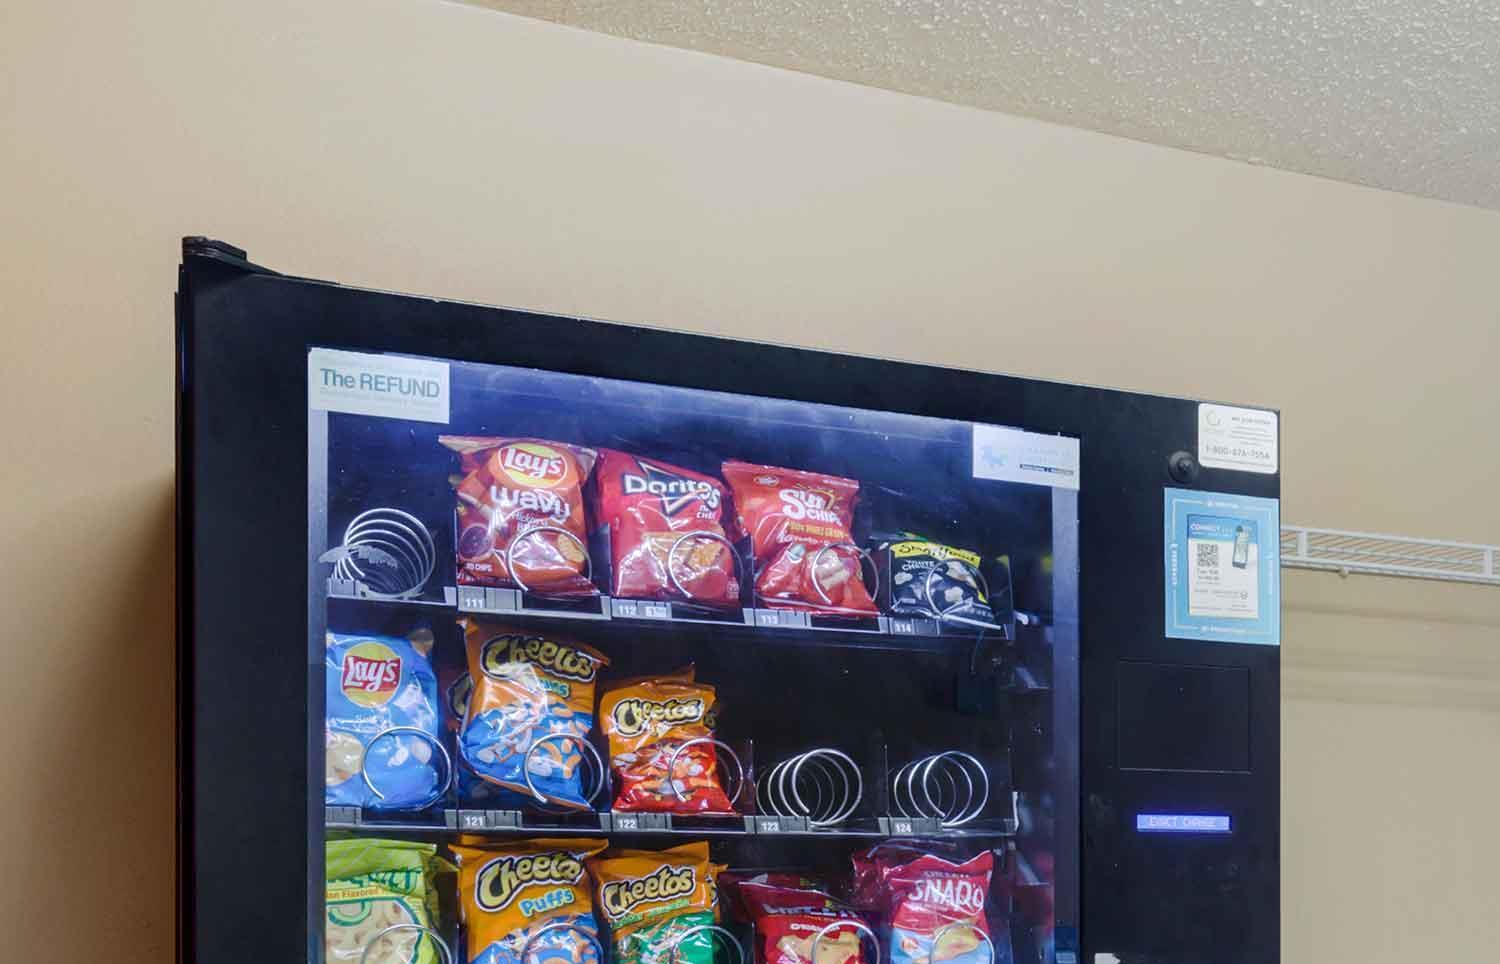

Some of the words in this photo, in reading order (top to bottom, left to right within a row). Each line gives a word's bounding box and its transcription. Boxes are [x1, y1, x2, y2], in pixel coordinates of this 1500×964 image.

[320, 368, 356, 390] The
[359, 374, 440, 398] REFUND
[624, 474, 720, 508] Doritos
[343, 656, 398, 693] Lay's
[614, 698, 704, 736] Cheetos
[465, 815, 484, 826] 121
[617, 819, 637, 829] 122
[761, 822, 780, 832] 123
[895, 823, 912, 833] 124
[520, 887, 576, 917] Puffs
[605, 867, 693, 916] Cheetos
